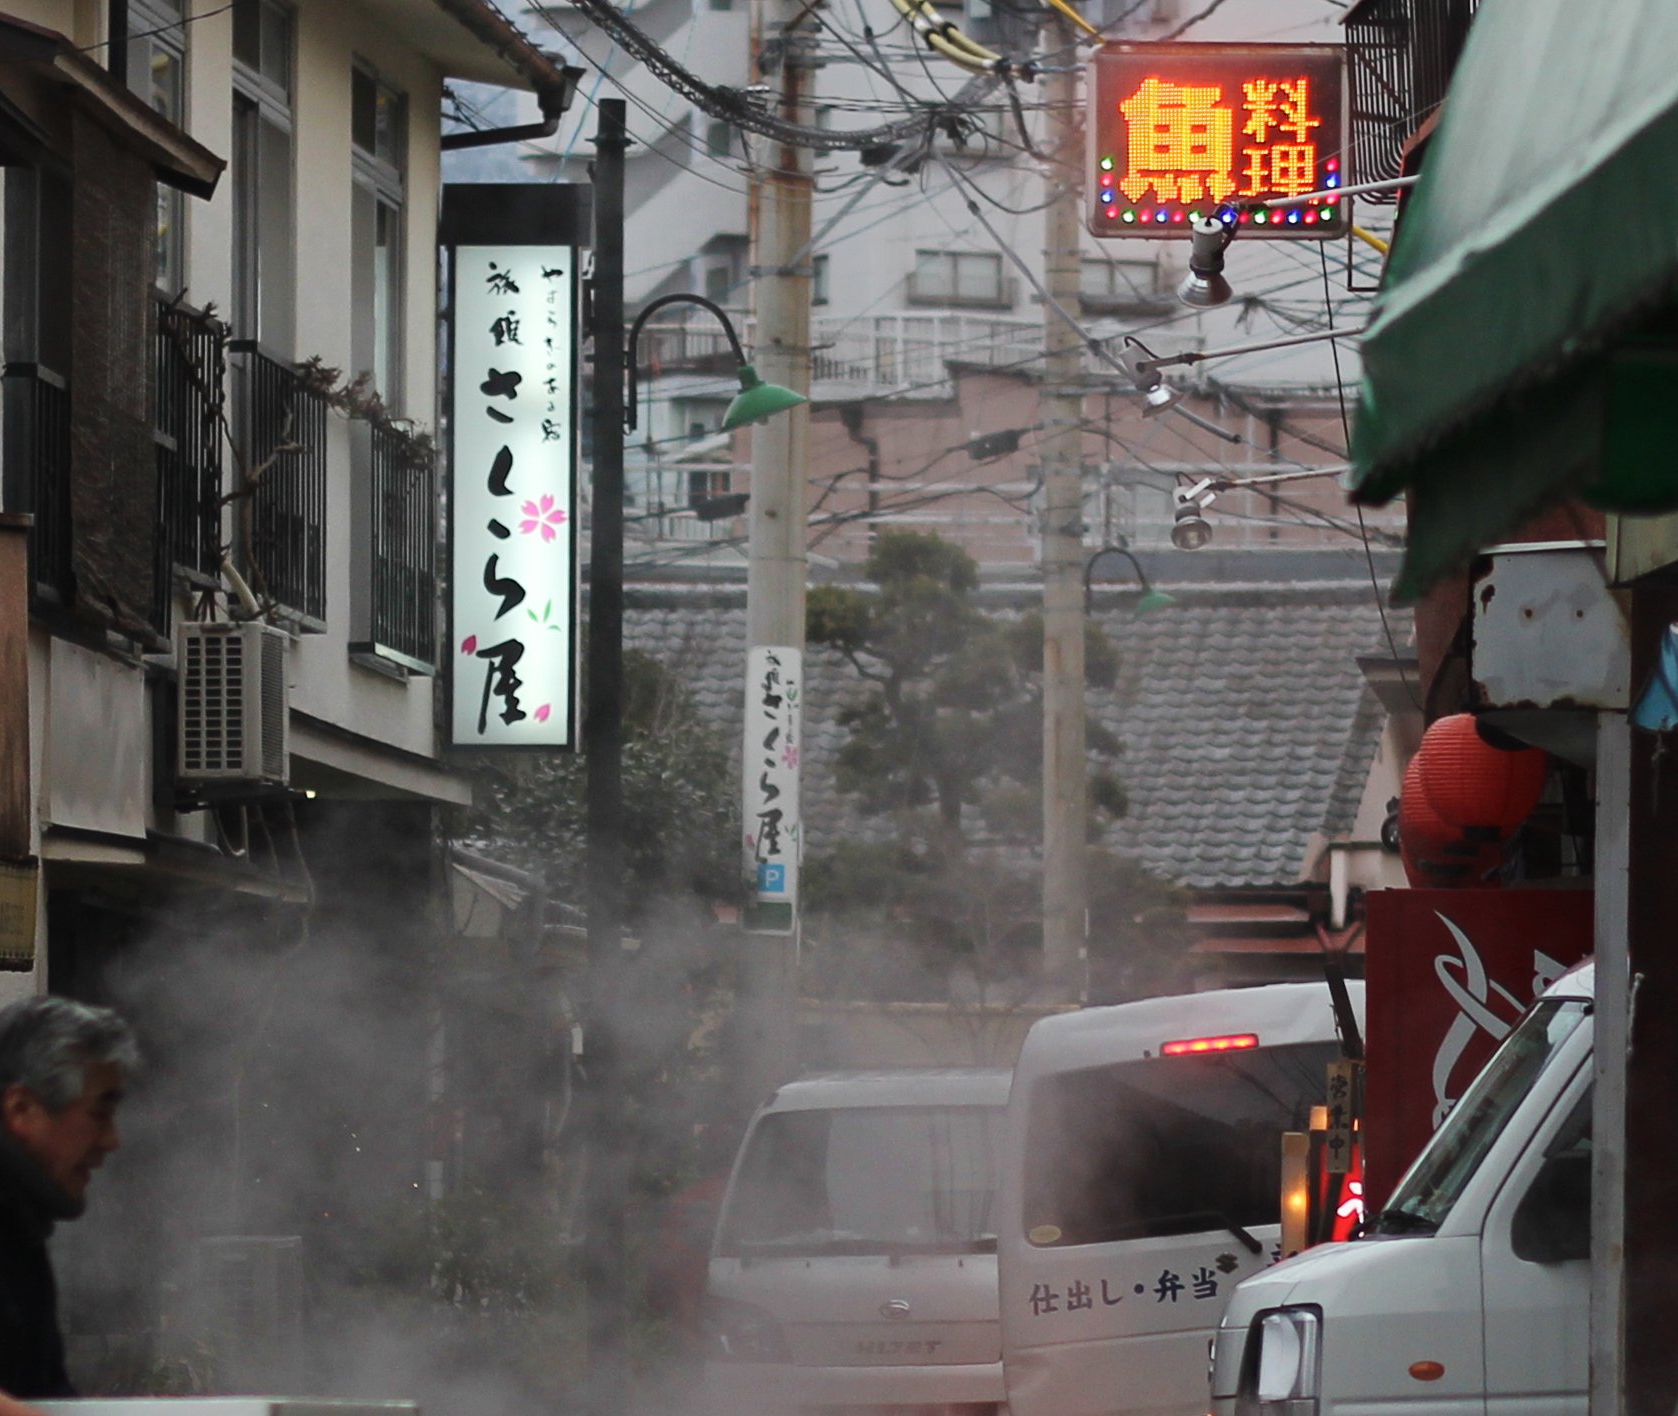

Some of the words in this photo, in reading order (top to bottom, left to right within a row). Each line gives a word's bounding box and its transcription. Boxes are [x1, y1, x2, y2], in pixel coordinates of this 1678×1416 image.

[765, 869, 779, 886] P
[1029, 1266, 1219, 1316] 仕出し・弁当
